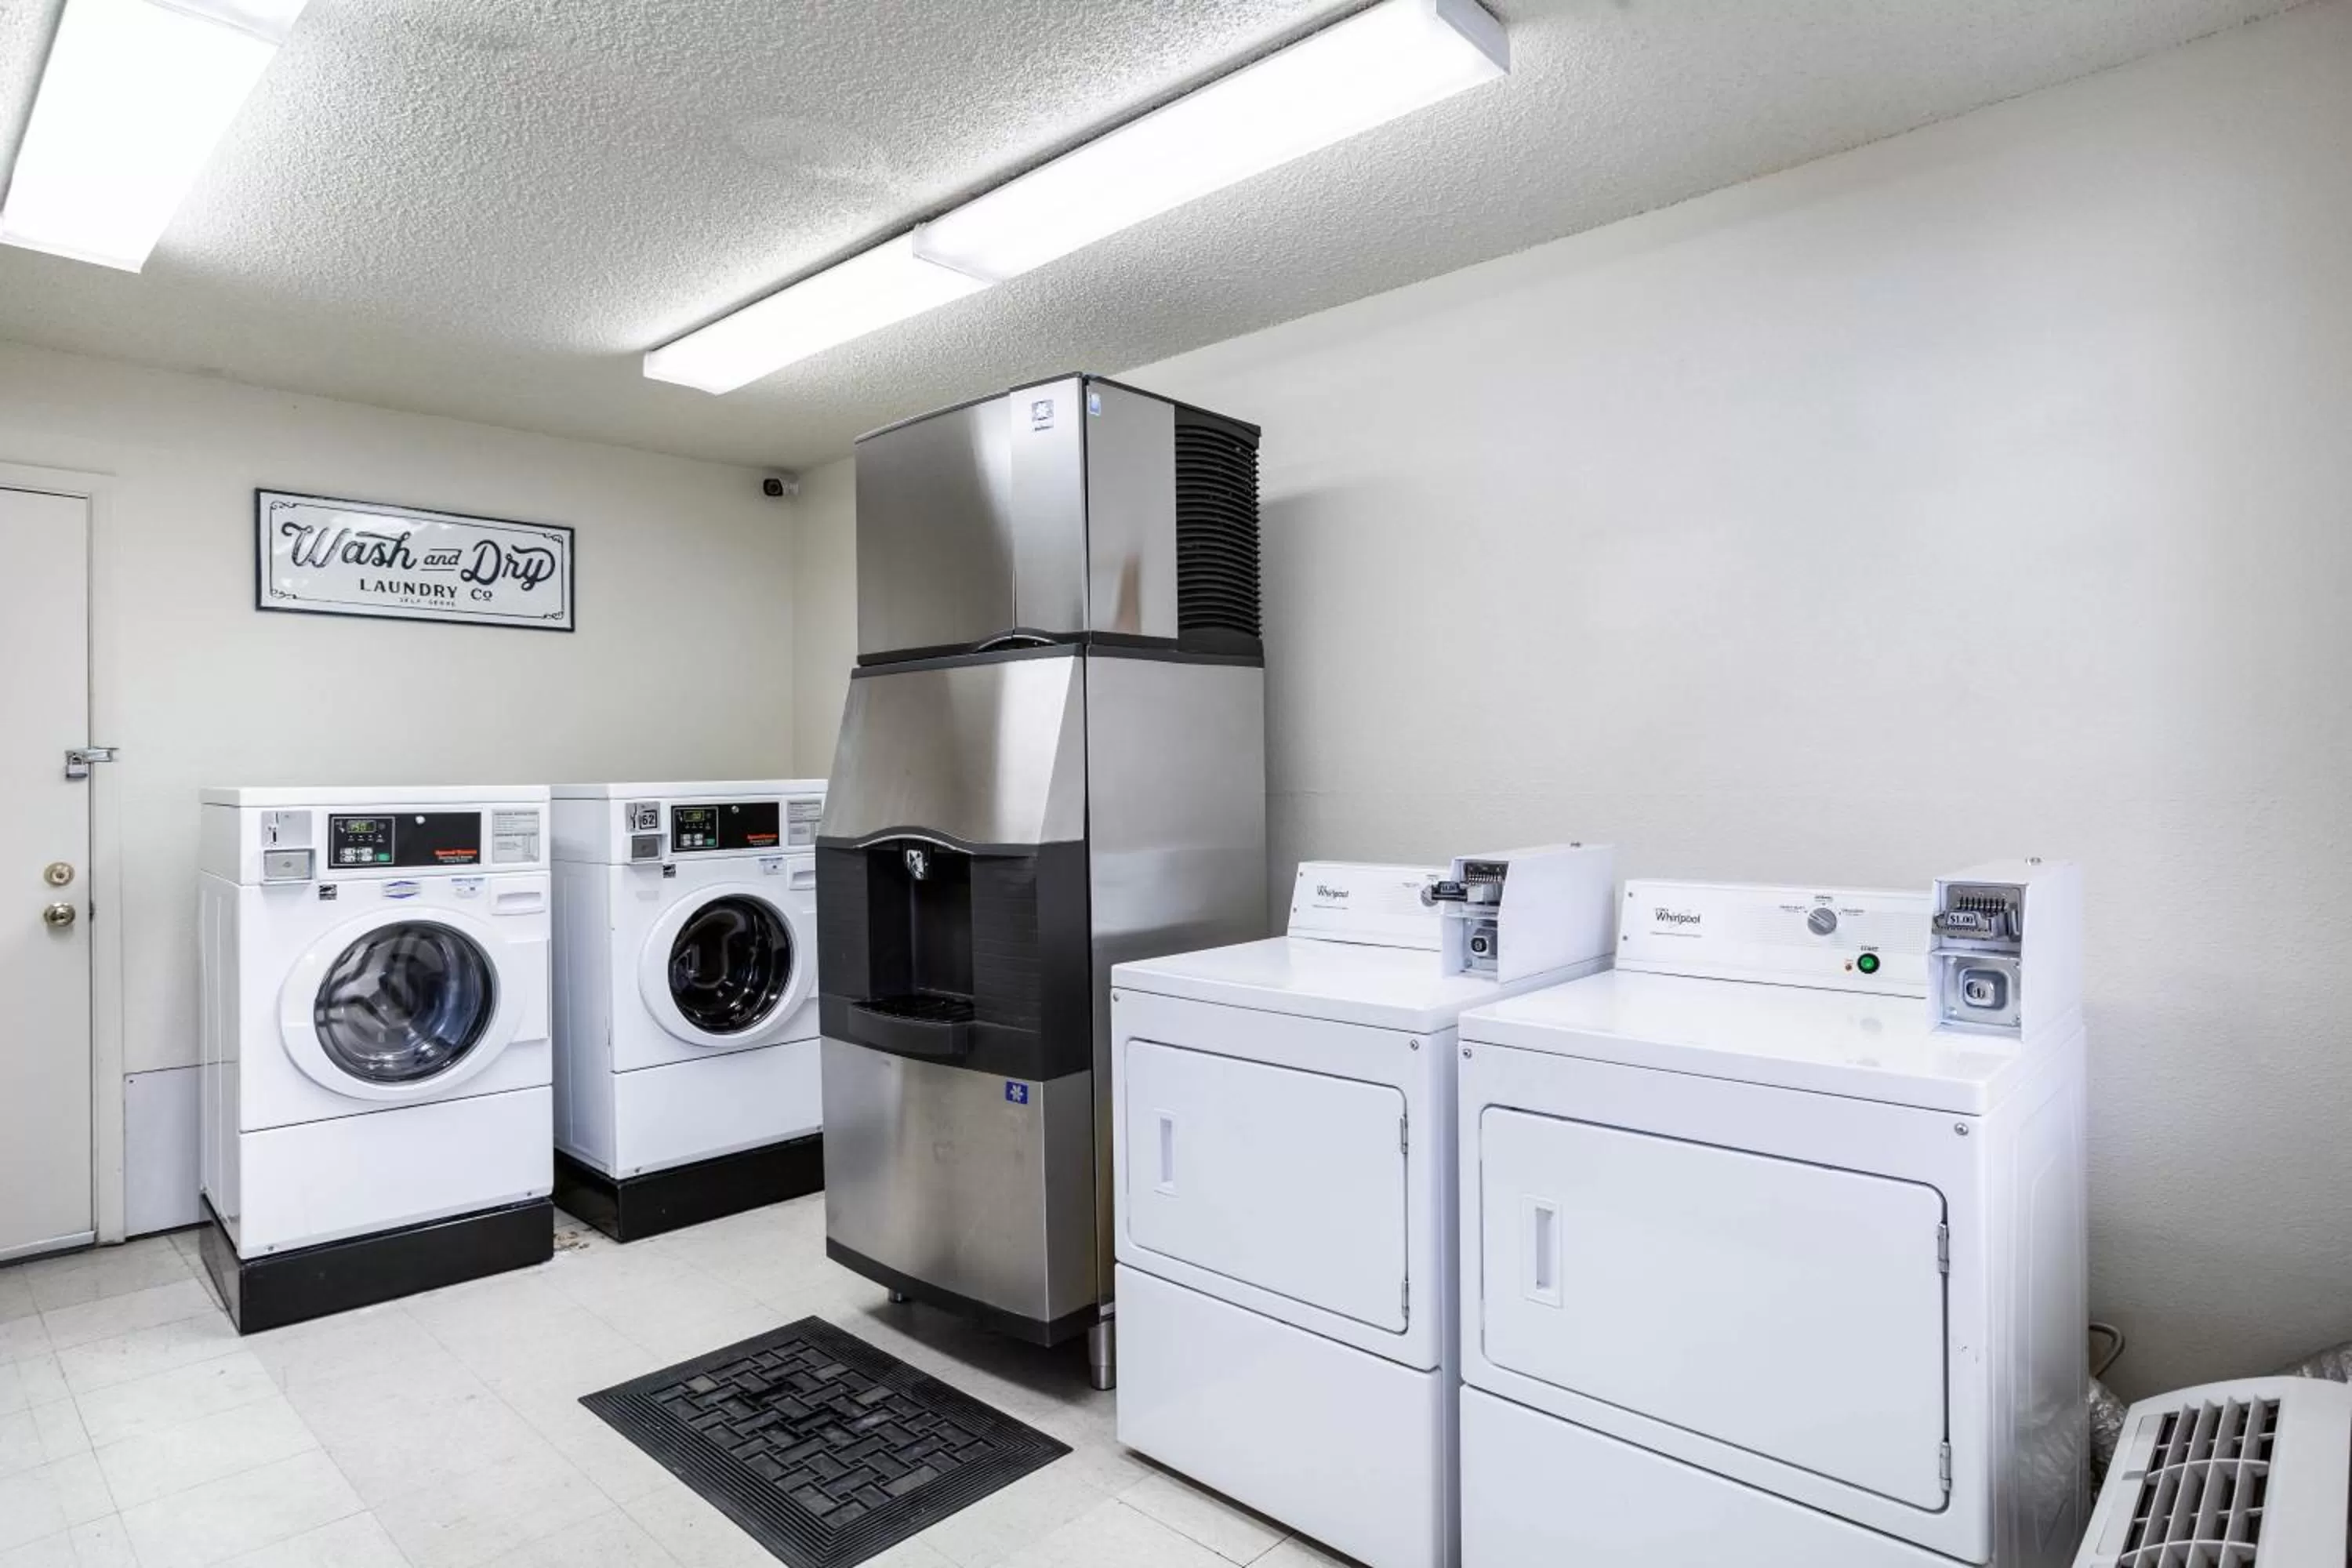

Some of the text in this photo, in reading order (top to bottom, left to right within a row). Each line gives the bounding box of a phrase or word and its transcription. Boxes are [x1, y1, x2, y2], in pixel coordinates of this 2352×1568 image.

[281, 522, 555, 591] Wash and Dry
[360, 579, 457, 598] LAUNDRY
[1655, 911, 1700, 925] Whirlpool
[1950, 914, 1974, 924] $1.00
